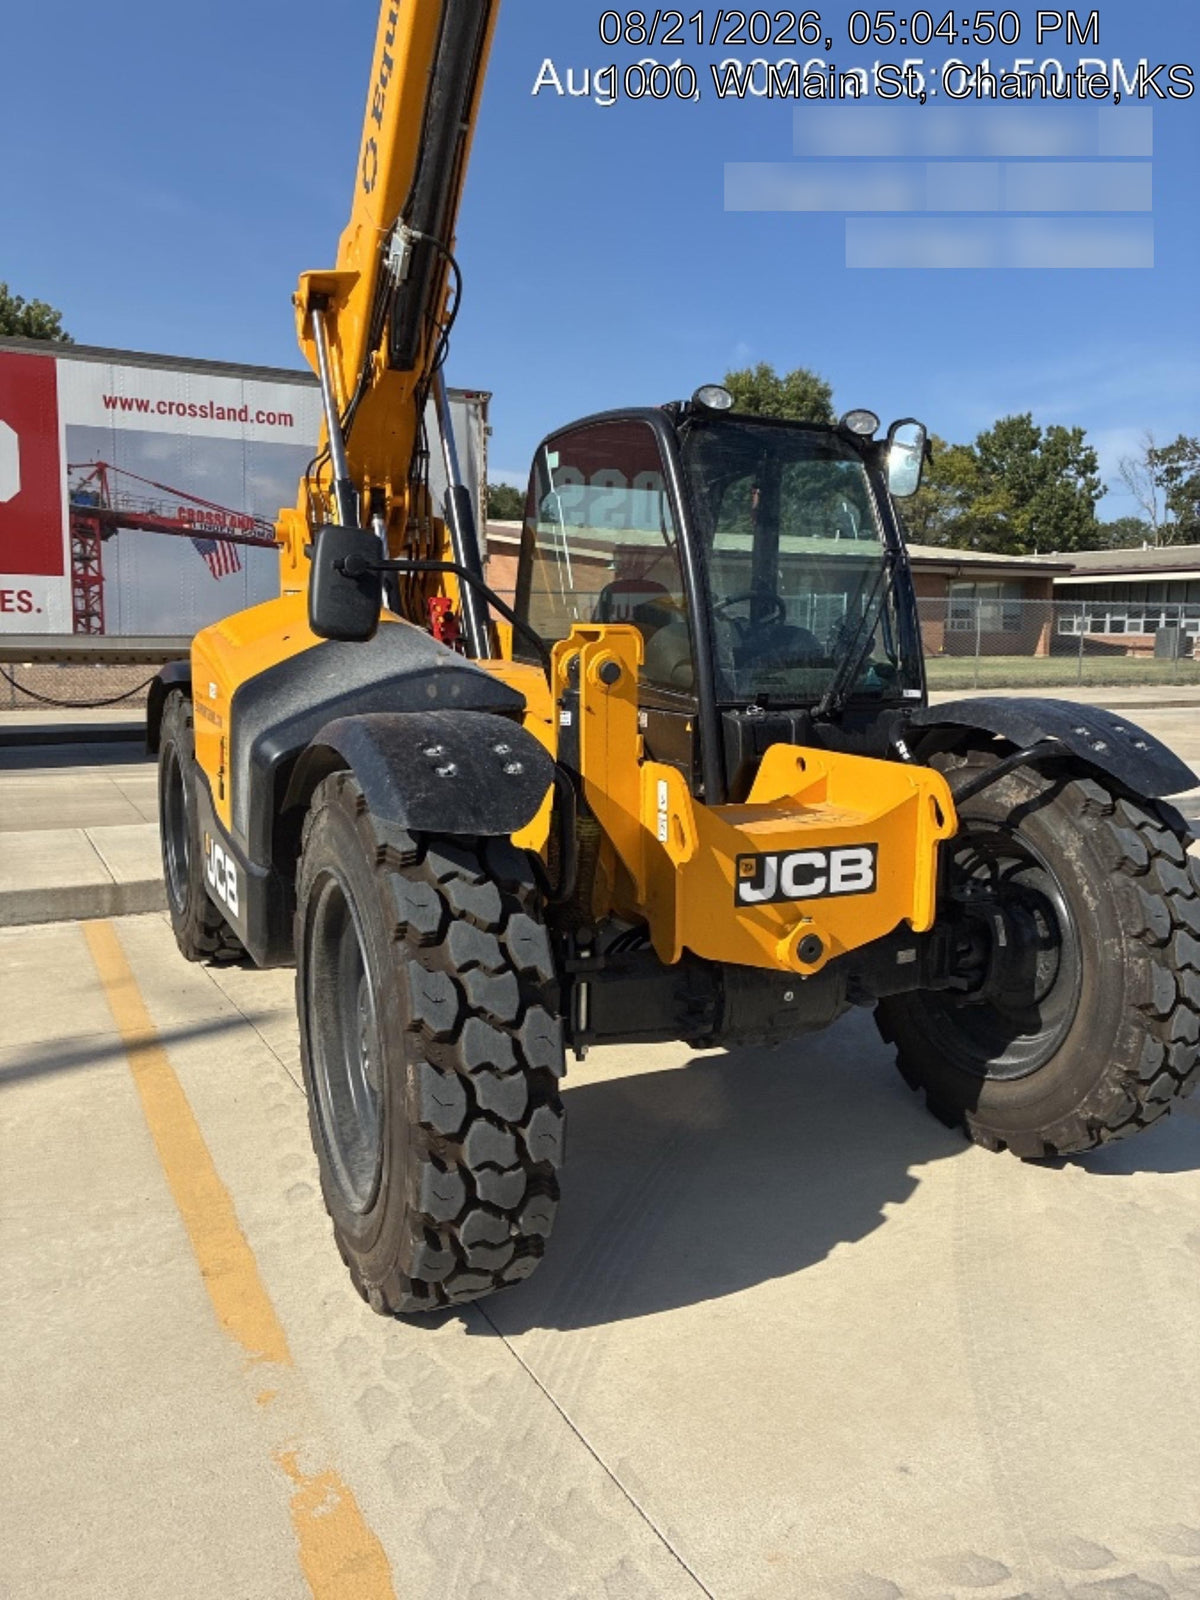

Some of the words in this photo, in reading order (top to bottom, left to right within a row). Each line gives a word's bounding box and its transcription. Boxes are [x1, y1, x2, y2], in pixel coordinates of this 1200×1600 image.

[103, 395, 294, 427] www.crossland.com
[207, 839, 239, 918] JCB
[739, 848, 874, 902] JCB
